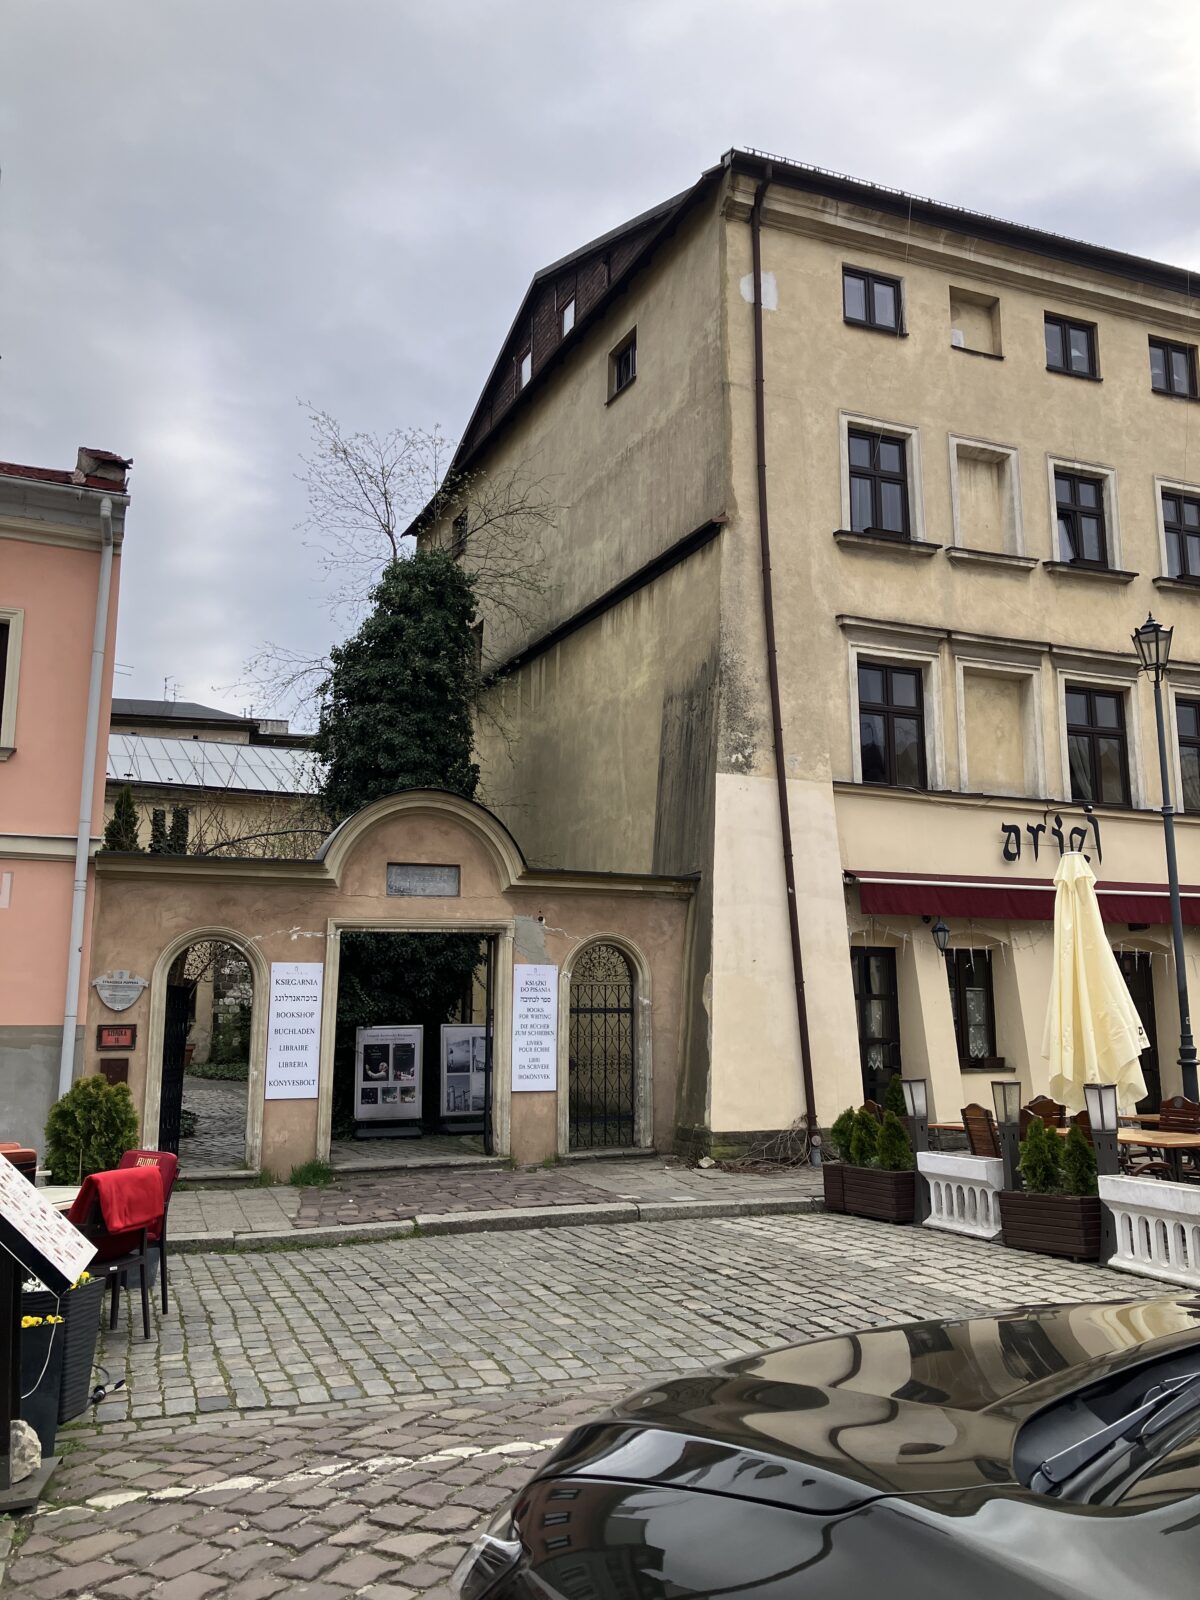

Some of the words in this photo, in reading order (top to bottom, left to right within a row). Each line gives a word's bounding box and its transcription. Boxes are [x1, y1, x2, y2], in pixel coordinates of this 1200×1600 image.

[1001, 814, 1102, 866] ariel
[276, 1011, 315, 1019] BOOKSHOP
[279, 1044, 309, 1052] LIBRAIRE
